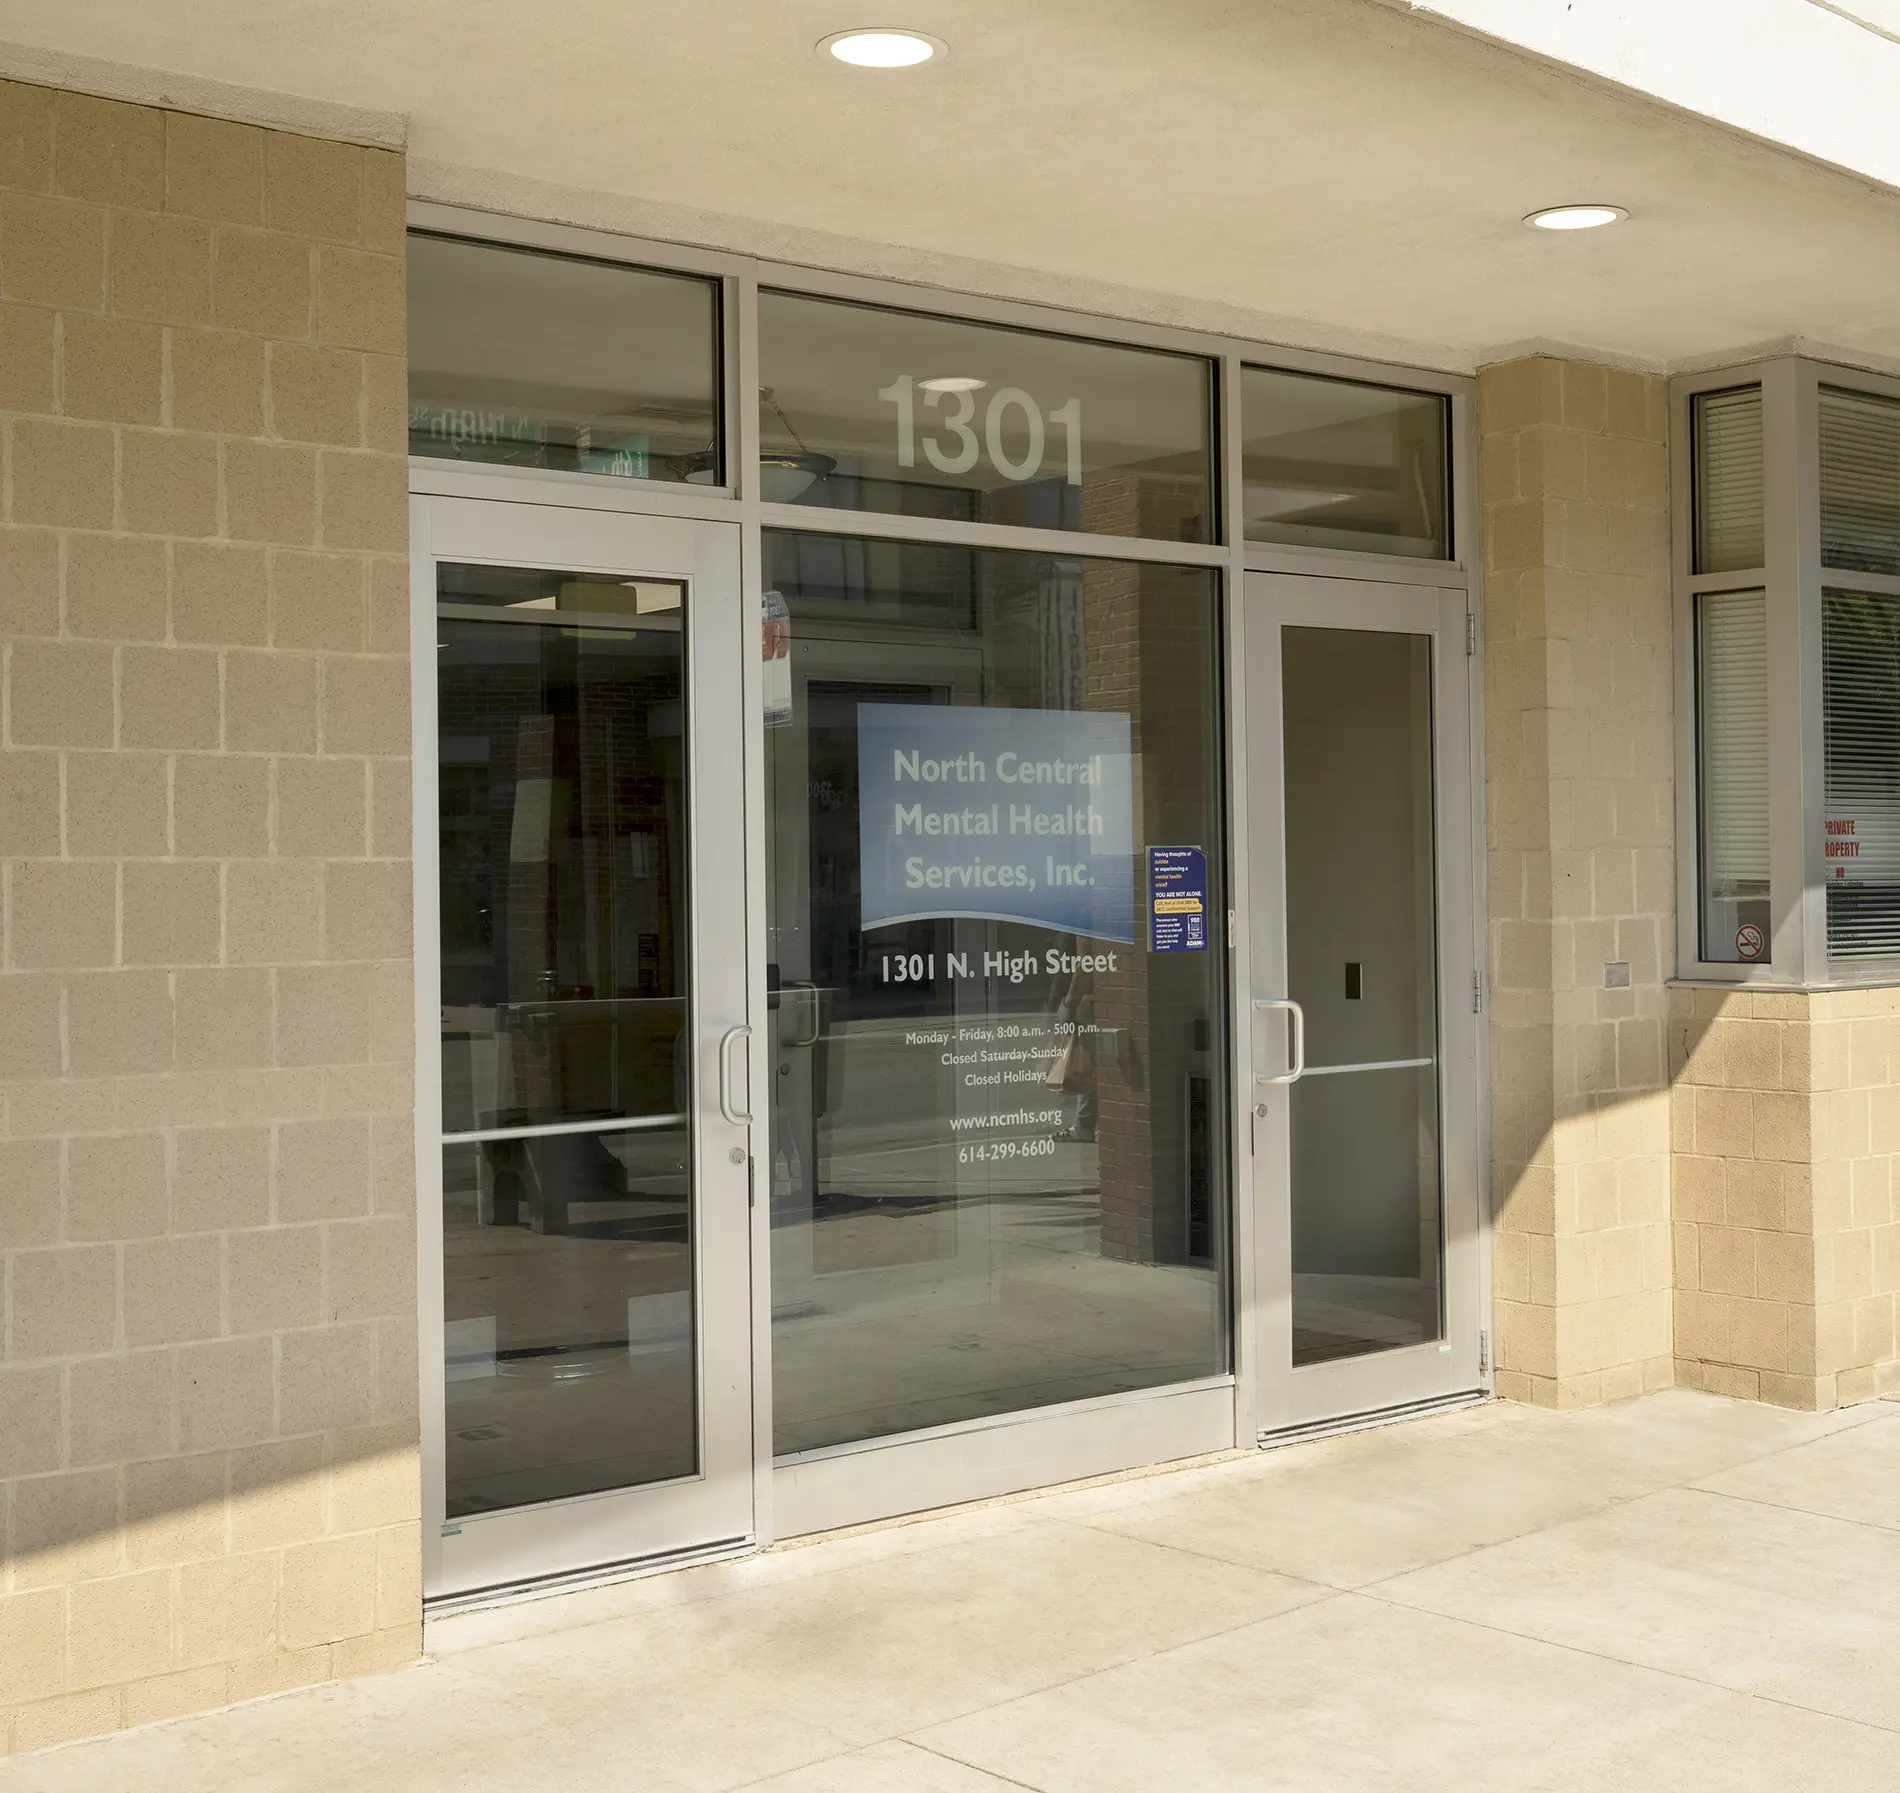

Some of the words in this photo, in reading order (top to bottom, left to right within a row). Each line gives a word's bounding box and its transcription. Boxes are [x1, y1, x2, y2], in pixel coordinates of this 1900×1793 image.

[878, 374, 1082, 486] 1301
[893, 750, 986, 783] North
[996, 752, 1102, 785] Central
[894, 804, 998, 836] Mental
[1009, 804, 1104, 836] Health
[1825, 842, 1860, 856] ROPERTY
[905, 856, 1036, 891] Services,
[1046, 856, 1095, 886] Inc.
[1836, 867, 1845, 878] NO
[882, 954, 934, 982] 1301
[947, 952, 975, 978] N.
[984, 950, 1038, 983] High
[1046, 948, 1117, 974] Street
[906, 1032, 949, 1045] Monday
[960, 1028, 994, 1042] Friday,
[996, 1026, 1019, 1038] 8:00
[1022, 1028, 1044, 1037] a.m.
[1054, 1022, 1075, 1034] 5:00
[1078, 1024, 1100, 1037] p.m.
[941, 1052, 978, 1066] Closed
[980, 1046, 1068, 1063] Saturday-Sunday
[964, 1072, 1000, 1086] Closed
[1004, 1070, 1048, 1084] Holidays
[950, 1108, 1062, 1130] www.ncmhs.org
[959, 1139, 1055, 1163] 614-299-6600
